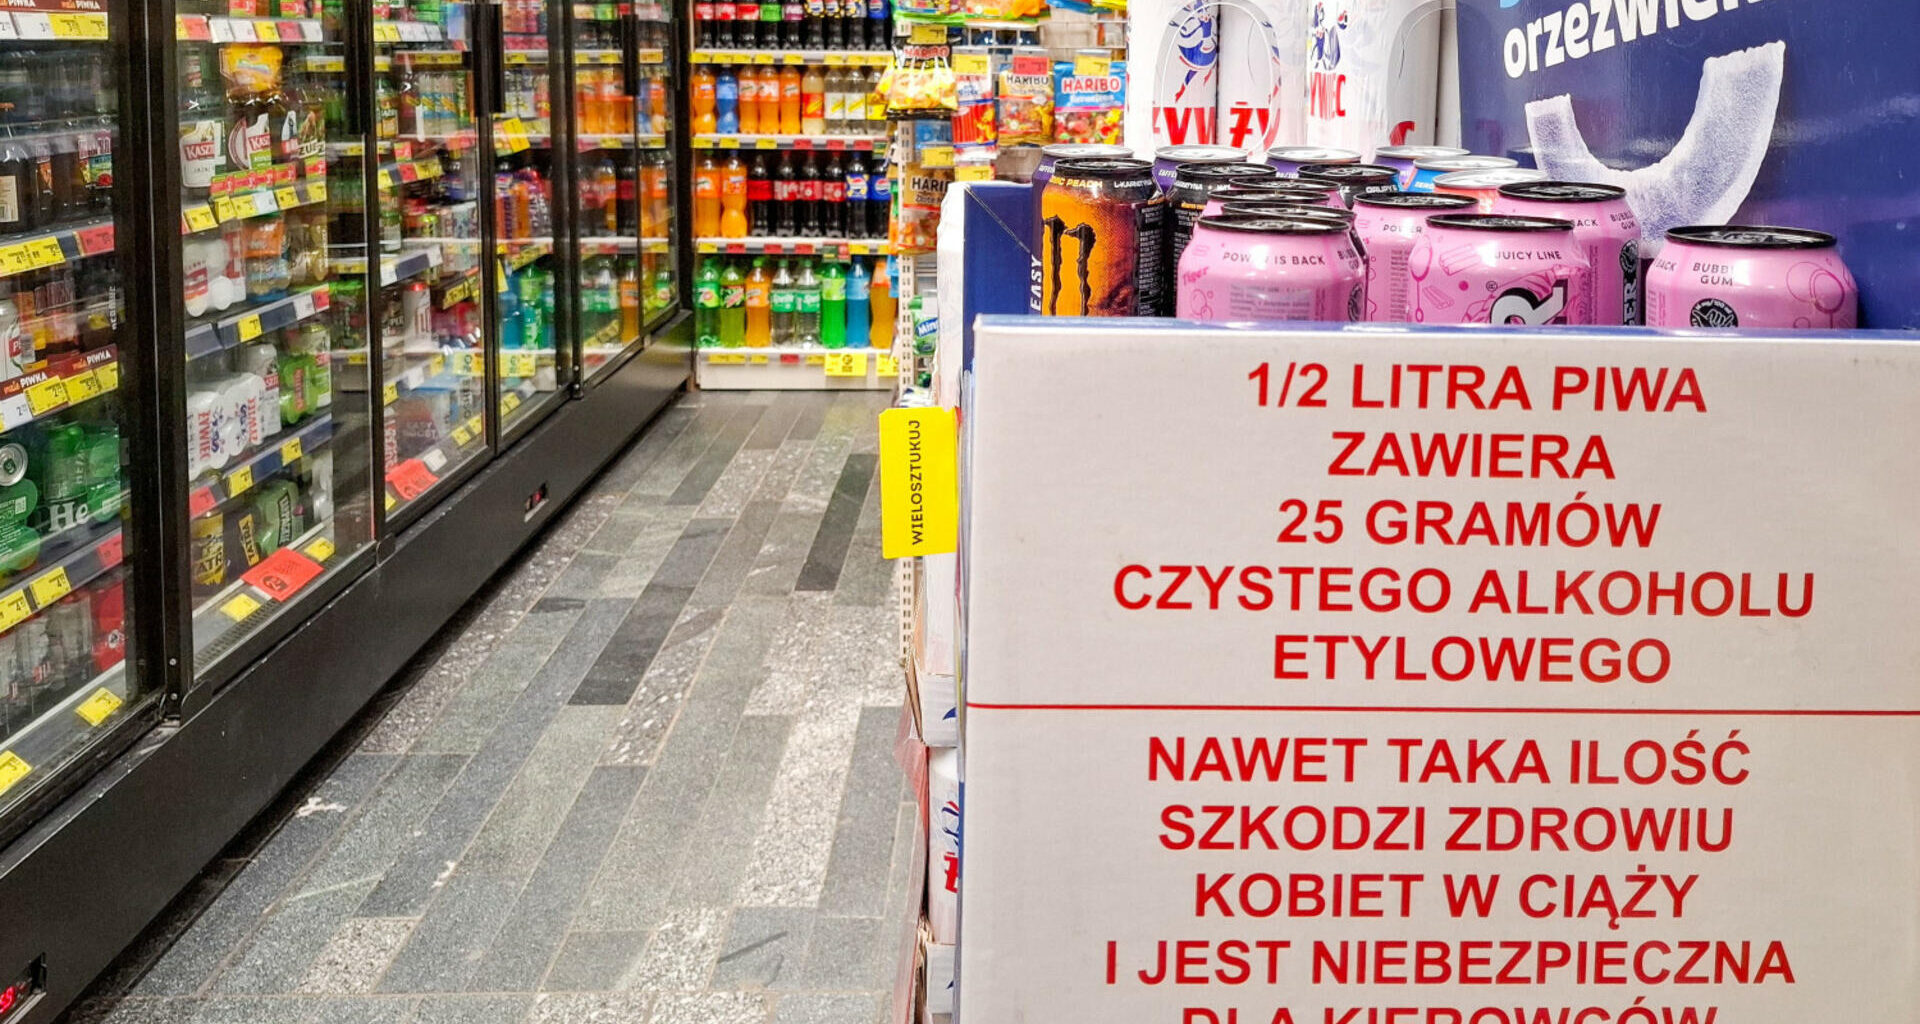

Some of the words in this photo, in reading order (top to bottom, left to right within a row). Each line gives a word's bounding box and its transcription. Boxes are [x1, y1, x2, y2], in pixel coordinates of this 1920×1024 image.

[1063, 77, 1120, 92] HARIBO
[1066, 178, 1103, 190] PEACH
[1382, 223, 1423, 233] POR
[1274, 255, 1287, 265] IS
[1292, 256, 1326, 266] BACK
[1495, 250, 1533, 260] JUICY
[1537, 250, 1563, 260] LINE
[1030, 256, 1043, 311] EASY
[1699, 274, 1734, 287] GUM
[19, 372, 49, 389] PIWKA
[86, 349, 113, 367] PIWKA
[1248, 362, 1328, 408] 1/2
[1352, 364, 1532, 411] LITRA
[1553, 366, 1707, 413] PIWA
[1328, 432, 1616, 479] ZAWIERA
[908, 420, 924, 546] WIELOSZTUKUJ
[48, 497, 91, 534] He
[1277, 499, 1344, 544] 25
[1366, 492, 1661, 548] GRAMÓW
[1114, 565, 1451, 613] CZYSTEGO
[1469, 569, 1814, 618] ALKOHOLU
[1274, 635, 1671, 683] ETYLOWEGO
[1149, 737, 1368, 782] NAWET
[1388, 738, 1551, 784] TAKA
[1571, 730, 1749, 785] ILOŚĆ
[1160, 805, 1425, 851] SZKODZI
[1445, 807, 1733, 852] ZDROWIU
[1196, 873, 1424, 918] KOBIET
[1444, 874, 1500, 918] W
[1520, 865, 1698, 930] CIĄŻY
[1107, 941, 1117, 984] I
[1139, 940, 1291, 985] JEST
[1313, 941, 1795, 985] NIEBEZPIECZNA
